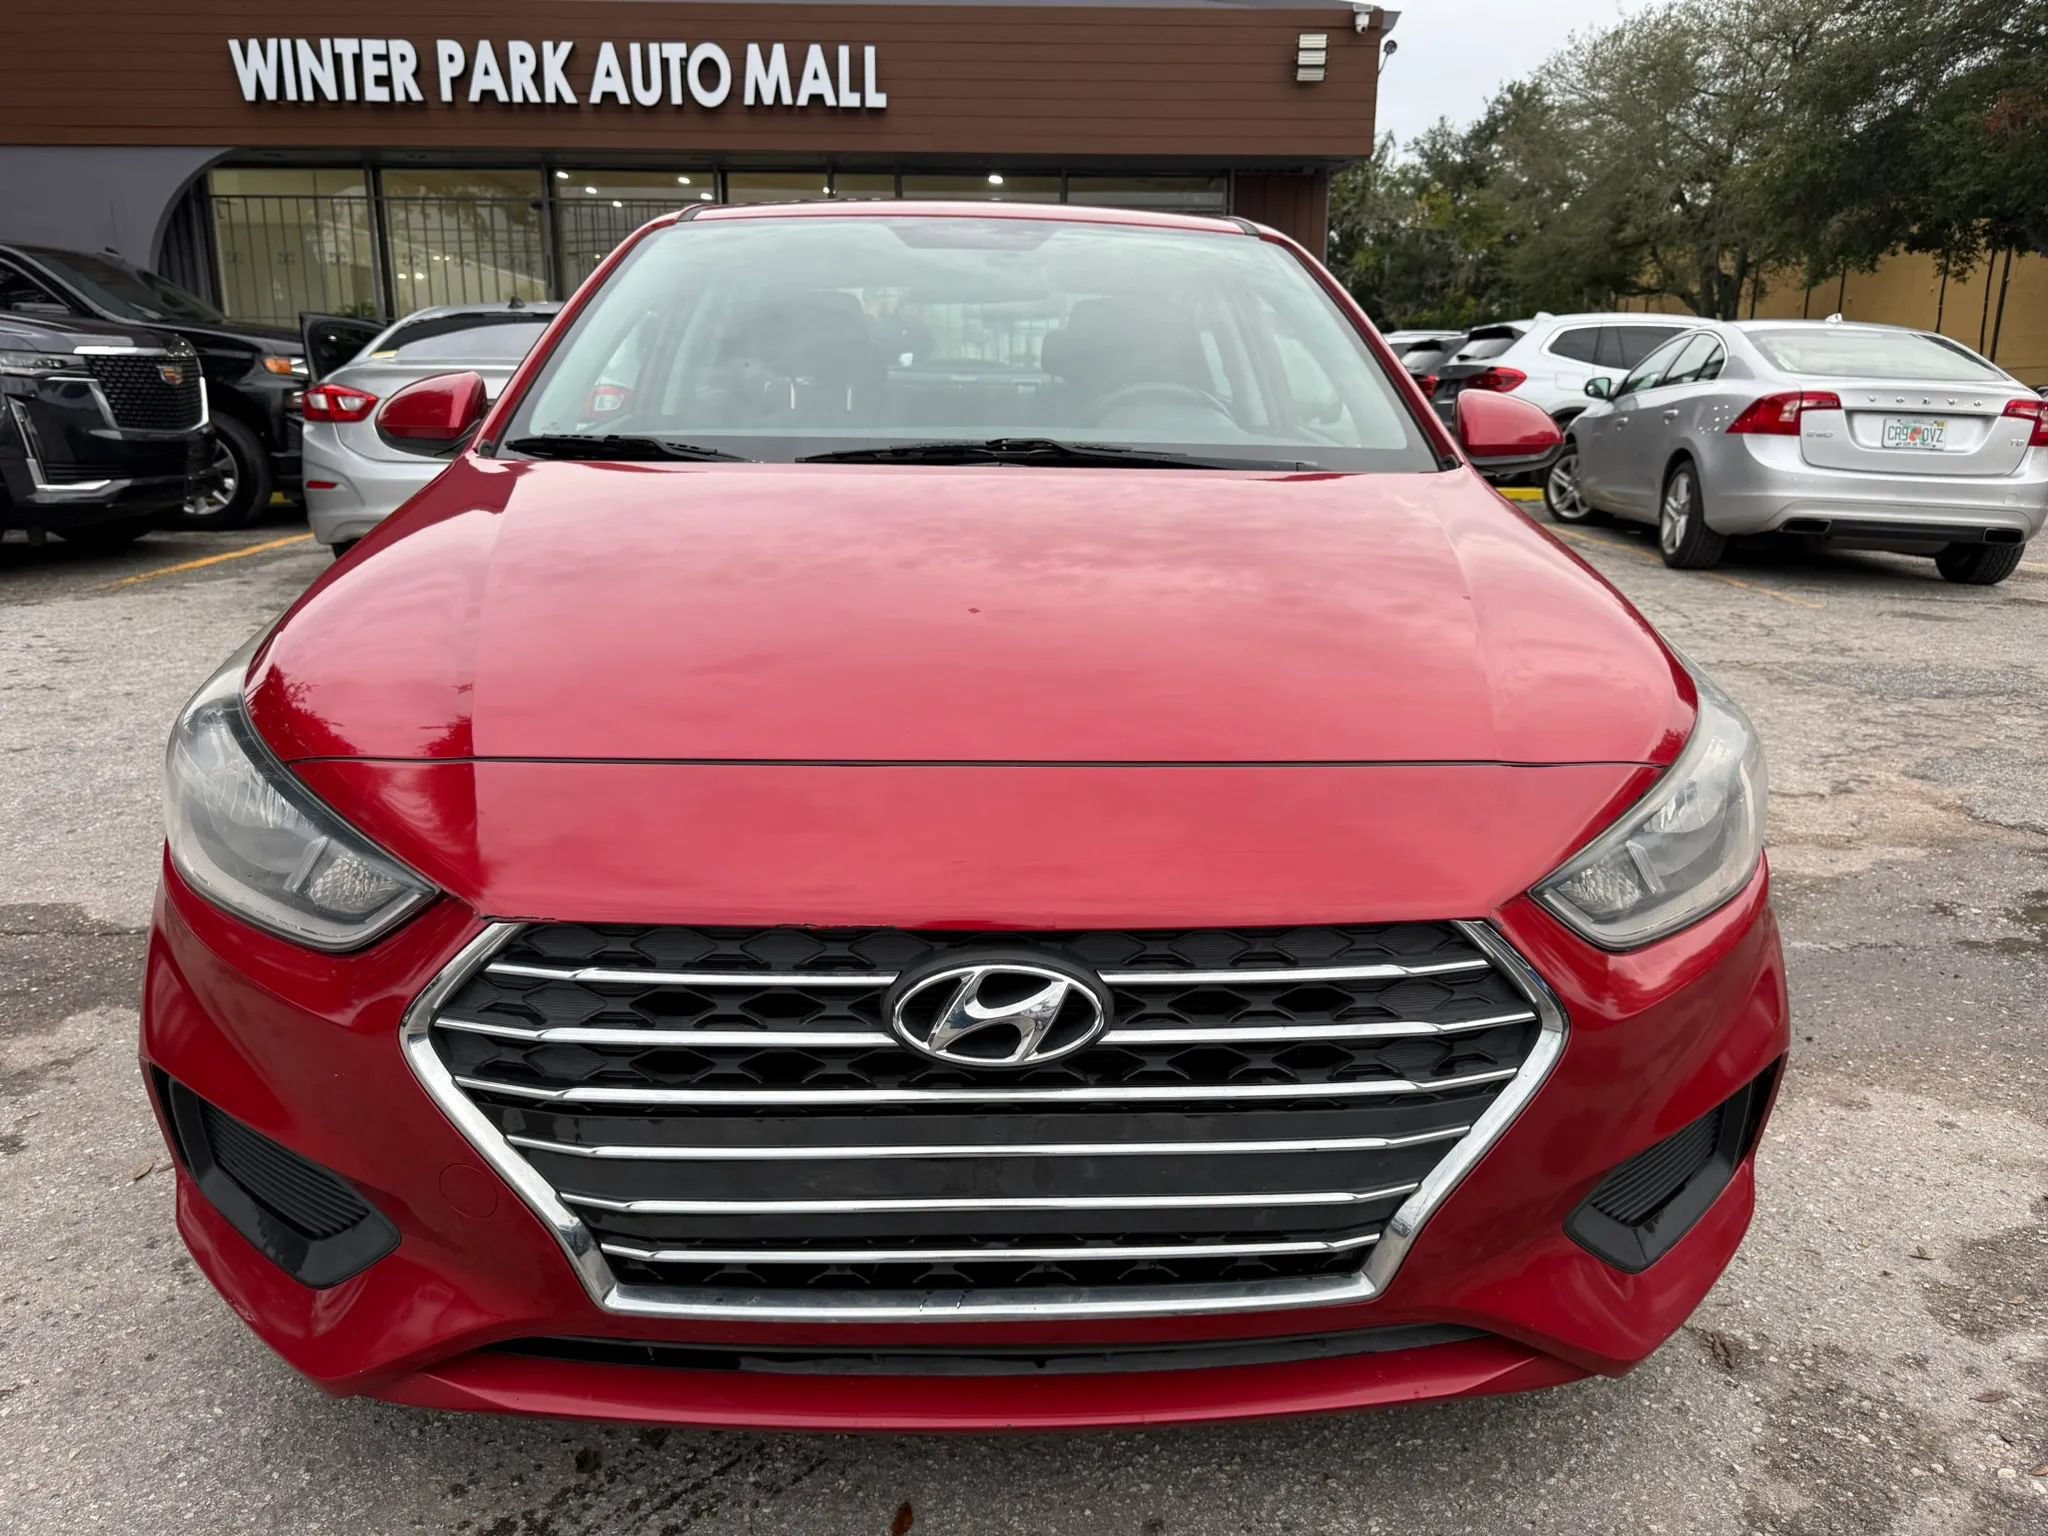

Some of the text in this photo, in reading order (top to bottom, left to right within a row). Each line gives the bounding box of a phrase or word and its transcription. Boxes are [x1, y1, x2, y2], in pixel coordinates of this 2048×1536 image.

[229, 38, 887, 108] WINTER PARK AUTO MALL
[1867, 395, 1983, 407] VOLVO
